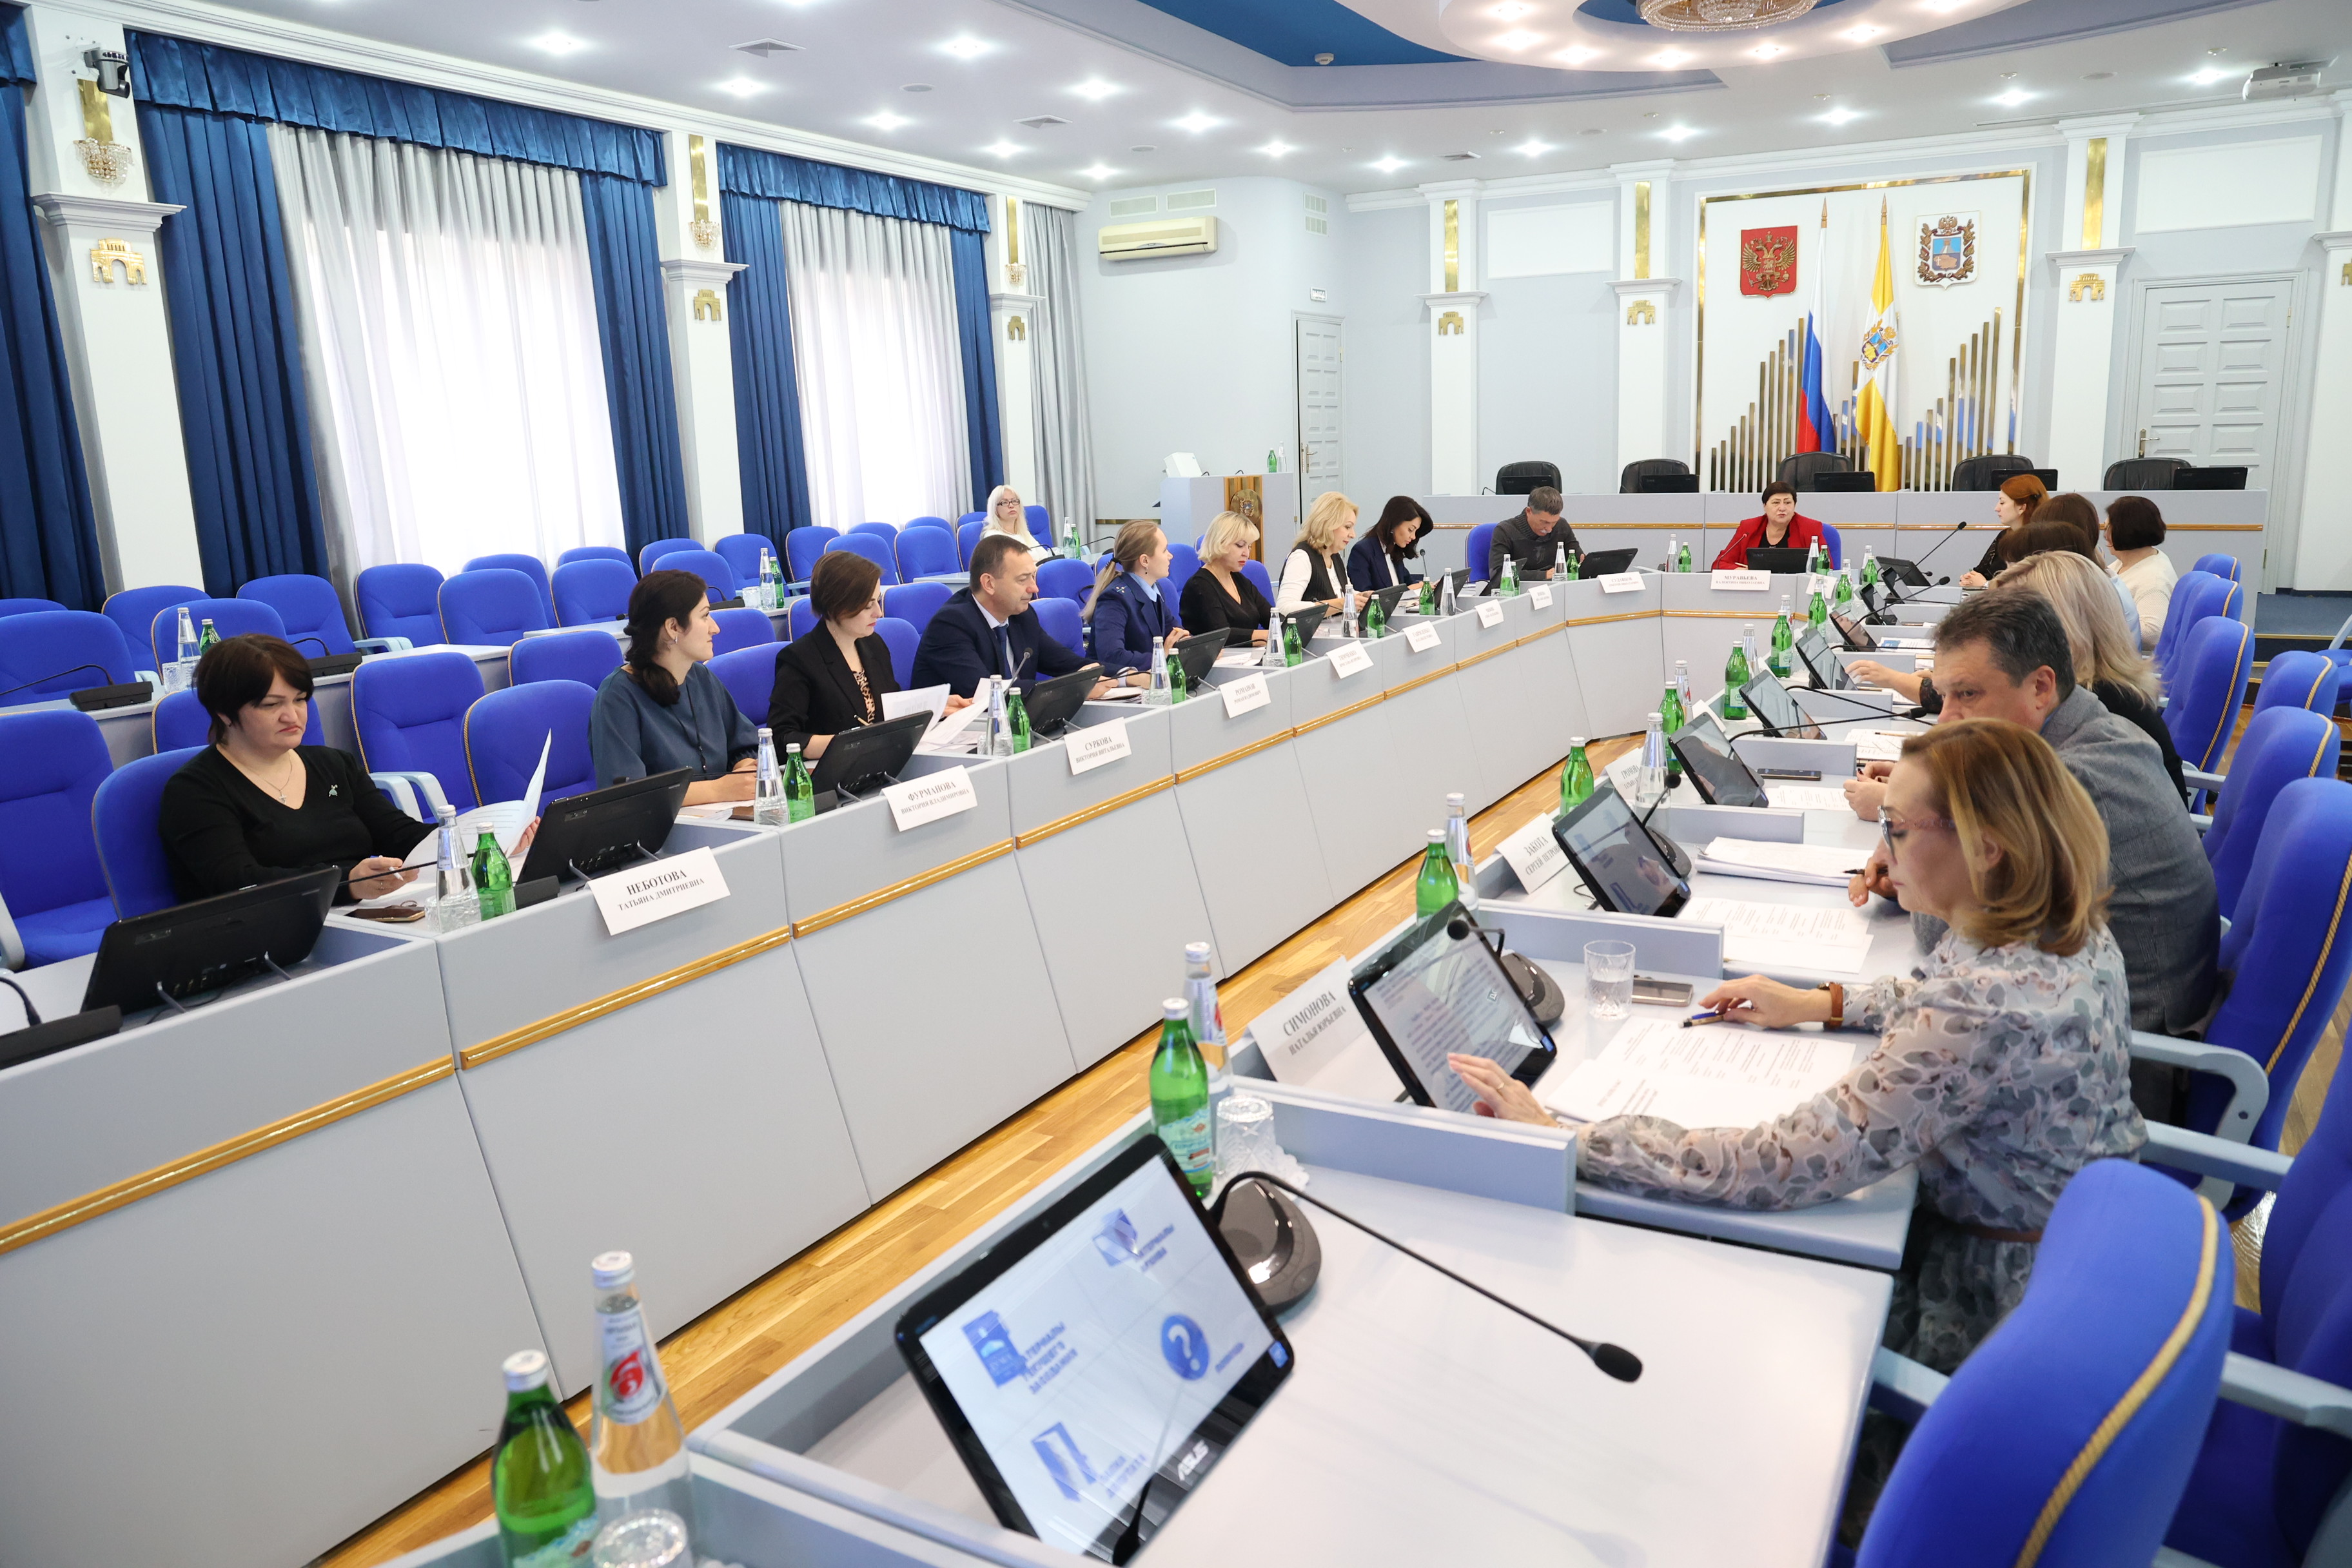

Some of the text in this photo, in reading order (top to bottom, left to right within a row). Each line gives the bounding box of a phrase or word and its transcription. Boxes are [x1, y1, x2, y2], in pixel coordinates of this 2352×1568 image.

[1235, 683, 1256, 696] РОМАНОВ
[1075, 743, 1125, 763] ВИКТОРИЯ ВИТАЛЬЕВНА
[1085, 736, 1112, 751] СУРКОВА
[901, 789, 970, 814] ВИКТОРИЯ ВЛАДИМИРОВНА
[908, 781, 956, 801] ФУРМАНОВА
[1524, 836, 1549, 857] ЗАКОТА
[1525, 856, 1544, 876] СЕРГЕЙ
[618, 877, 705, 911] ТАТЬЯНА ДМИТРИЕВНА
[626, 870, 687, 896] НЕБОТОВА
[1283, 990, 1336, 1037] СИМОНОВА
[1288, 1026, 1319, 1055] НАТАЛЬЯ
[1177, 1439, 1210, 1481] ASUS
